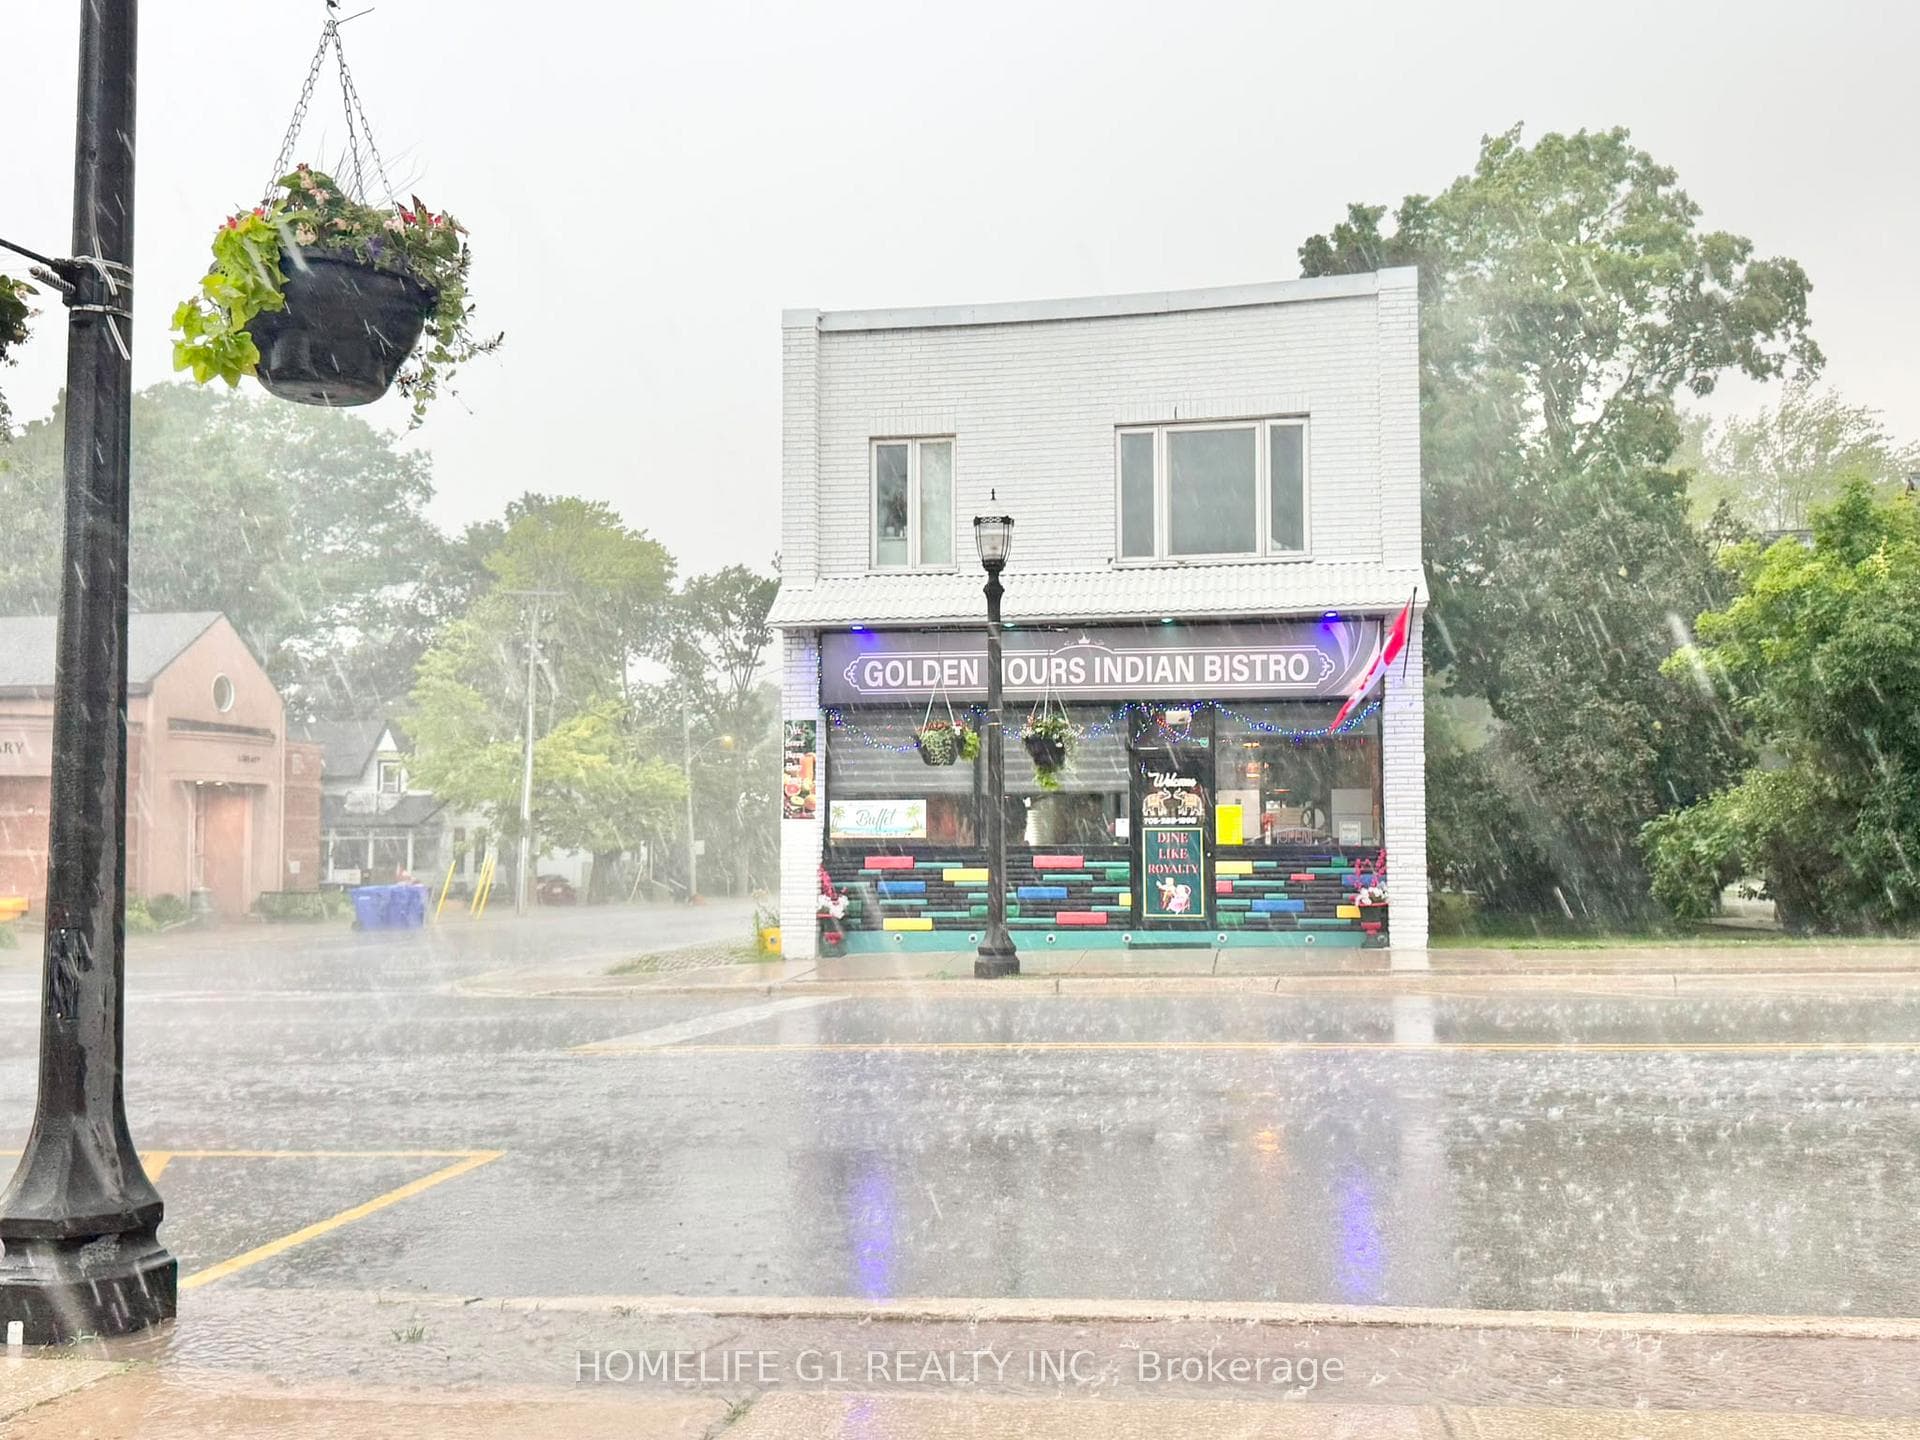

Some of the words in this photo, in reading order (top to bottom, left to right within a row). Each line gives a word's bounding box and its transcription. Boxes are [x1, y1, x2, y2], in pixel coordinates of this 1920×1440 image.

[864, 658, 979, 687] GOLDEN
[1001, 657, 1087, 686] OURS
[1094, 655, 1195, 684] INDIAN
[1204, 653, 1310, 682] BISTRO
[1157, 832, 1189, 844] DINE
[1158, 848, 1188, 860] LIKE
[1148, 864, 1199, 875] ROYALTY
